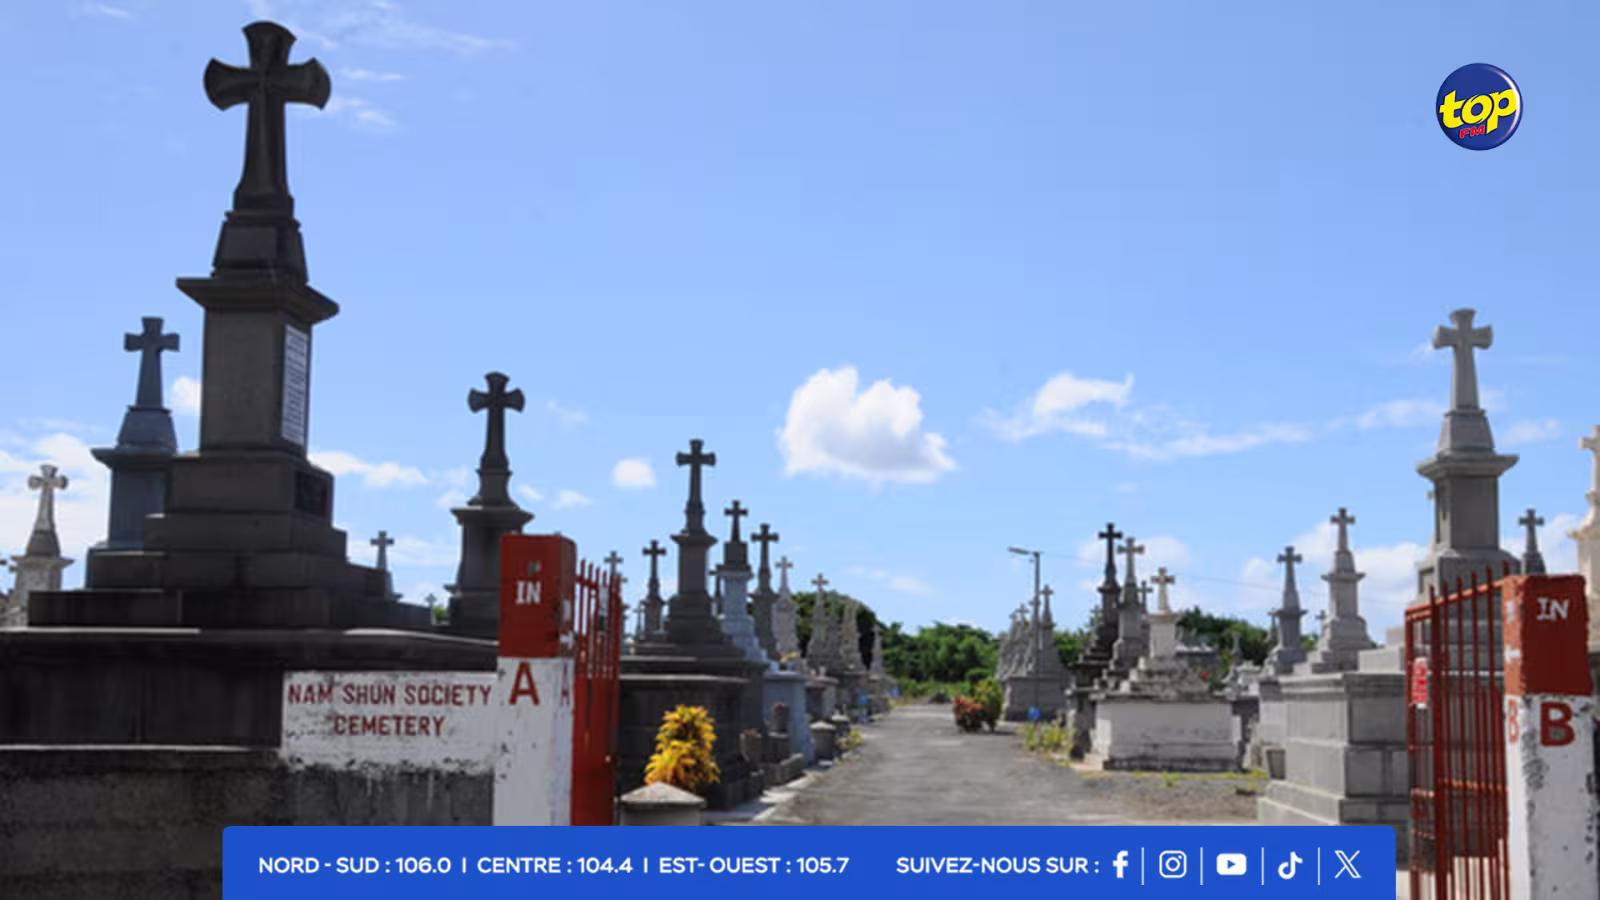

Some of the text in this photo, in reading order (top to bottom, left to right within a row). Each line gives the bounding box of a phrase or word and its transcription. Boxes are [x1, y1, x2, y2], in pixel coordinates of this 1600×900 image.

[515, 581, 541, 604] IN
[1536, 598, 1568, 621] IN
[509, 661, 540, 705] A
[288, 684, 492, 706] NAM SHUN SOCIETY
[333, 715, 446, 736] CEMETERY
[1540, 702, 1576, 747] B
